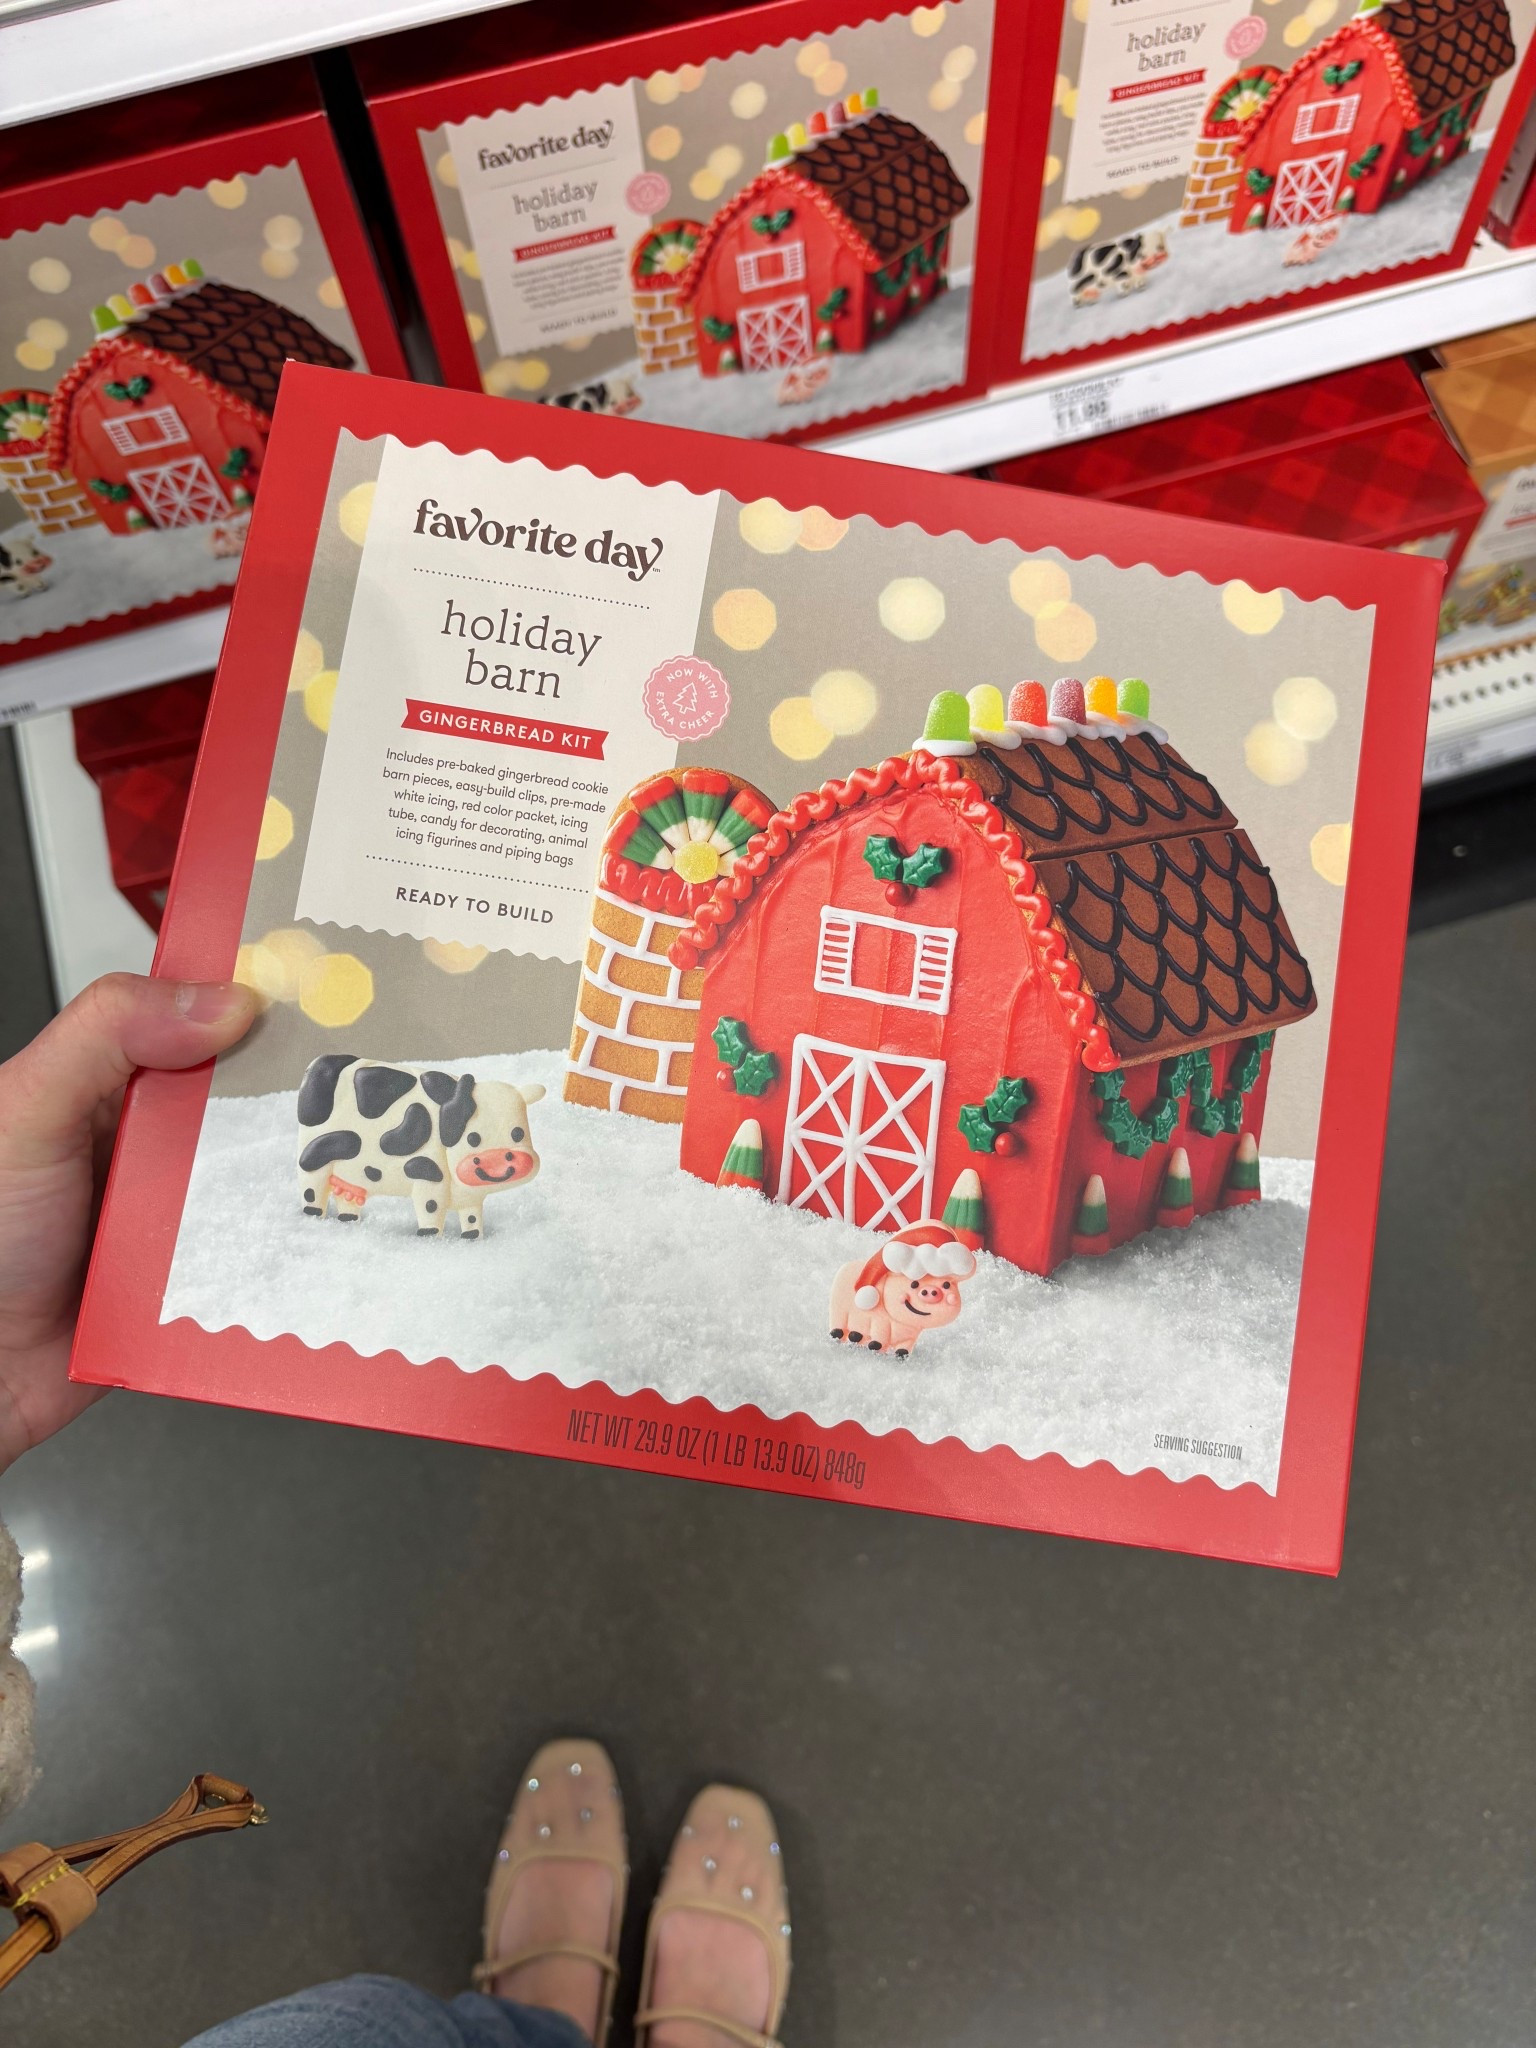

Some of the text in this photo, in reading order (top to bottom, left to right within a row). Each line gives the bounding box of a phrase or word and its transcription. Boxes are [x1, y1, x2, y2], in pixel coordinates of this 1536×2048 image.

[1127, 22, 1206, 52] holiday
[1137, 48, 1187, 72] barn
[477, 119, 614, 171] favorite day
[511, 181, 598, 215] holiday
[532, 207, 587, 233] barn
[413, 498, 664, 582] favorite day
[441, 599, 602, 667] holiday
[465, 648, 561, 699] barn
[666, 668, 718, 698] NOW WITH
[419, 709, 592, 749] GINGERBREAD KIT
[656, 691, 715, 729] EXTRA CHEER
[382, 767, 606, 814] barn pieces, easy-build clips, pre-made
[386, 748, 609, 795] Includes pre-baked gingerbread cookie
[388, 807, 588, 849] tube, candy for decorating, animal
[393, 789, 588, 832] white icing, red color packet, icing
[396, 827, 574, 868] icing figurines and piping bags
[396, 886, 554, 924] READY TO BUILD
[566, 1408, 867, 1490] NET WT 29.9 OZ (1 LB 13.9 OZ) 848g
[1153, 1433, 1243, 1461] SERVING SUGGESTION
